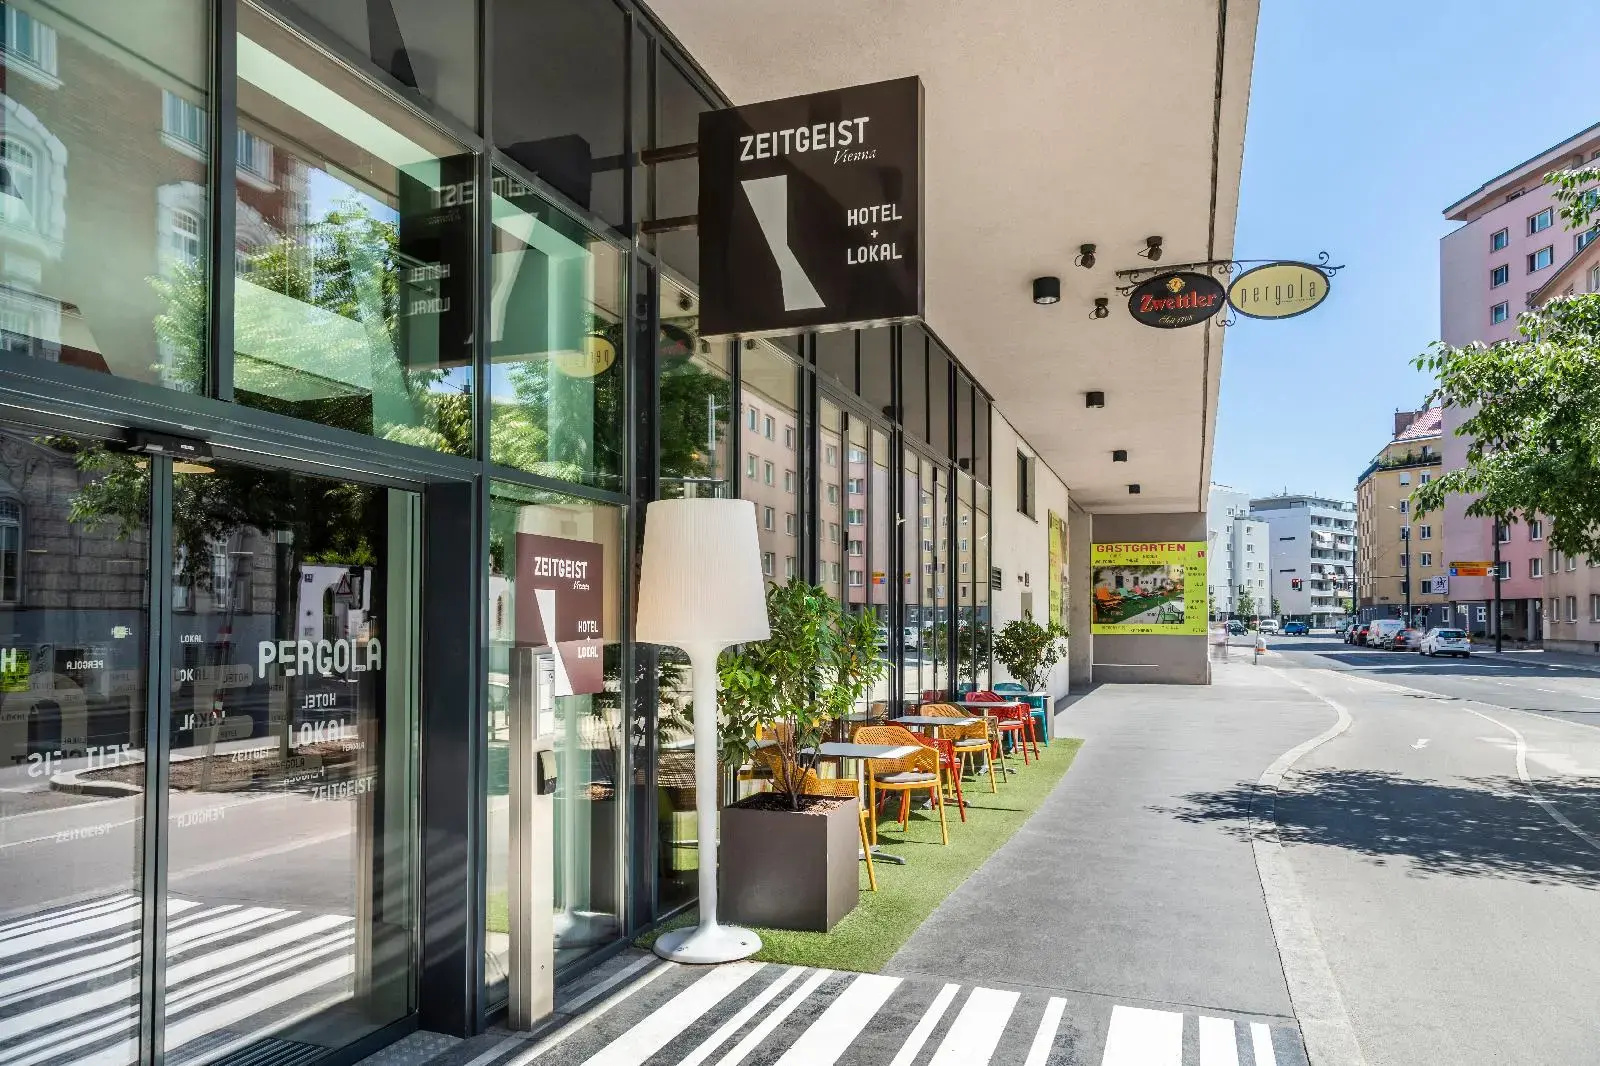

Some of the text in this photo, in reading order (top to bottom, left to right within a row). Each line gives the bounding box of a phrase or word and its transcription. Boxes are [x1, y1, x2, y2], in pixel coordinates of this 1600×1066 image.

[740, 117, 869, 162] ZEITGEIST
[833, 148, 877, 165] Vienna
[847, 203, 903, 226] HOTEL
[847, 243, 902, 265] LOKAL
[1140, 289, 1217, 313] Zwettler
[1241, 273, 1316, 308] pergola
[1096, 543, 1186, 553] GASTGARTEN
[534, 556, 588, 579] ZEITGEIST
[578, 620, 599, 633] HOTEL
[180, 634, 204, 643] LOKAL
[258, 637, 382, 679] PERGOLA
[577, 646, 599, 658] LOKAL
[288, 718, 347, 749] LOKAL
[311, 776, 373, 803] ZEITGEIST
